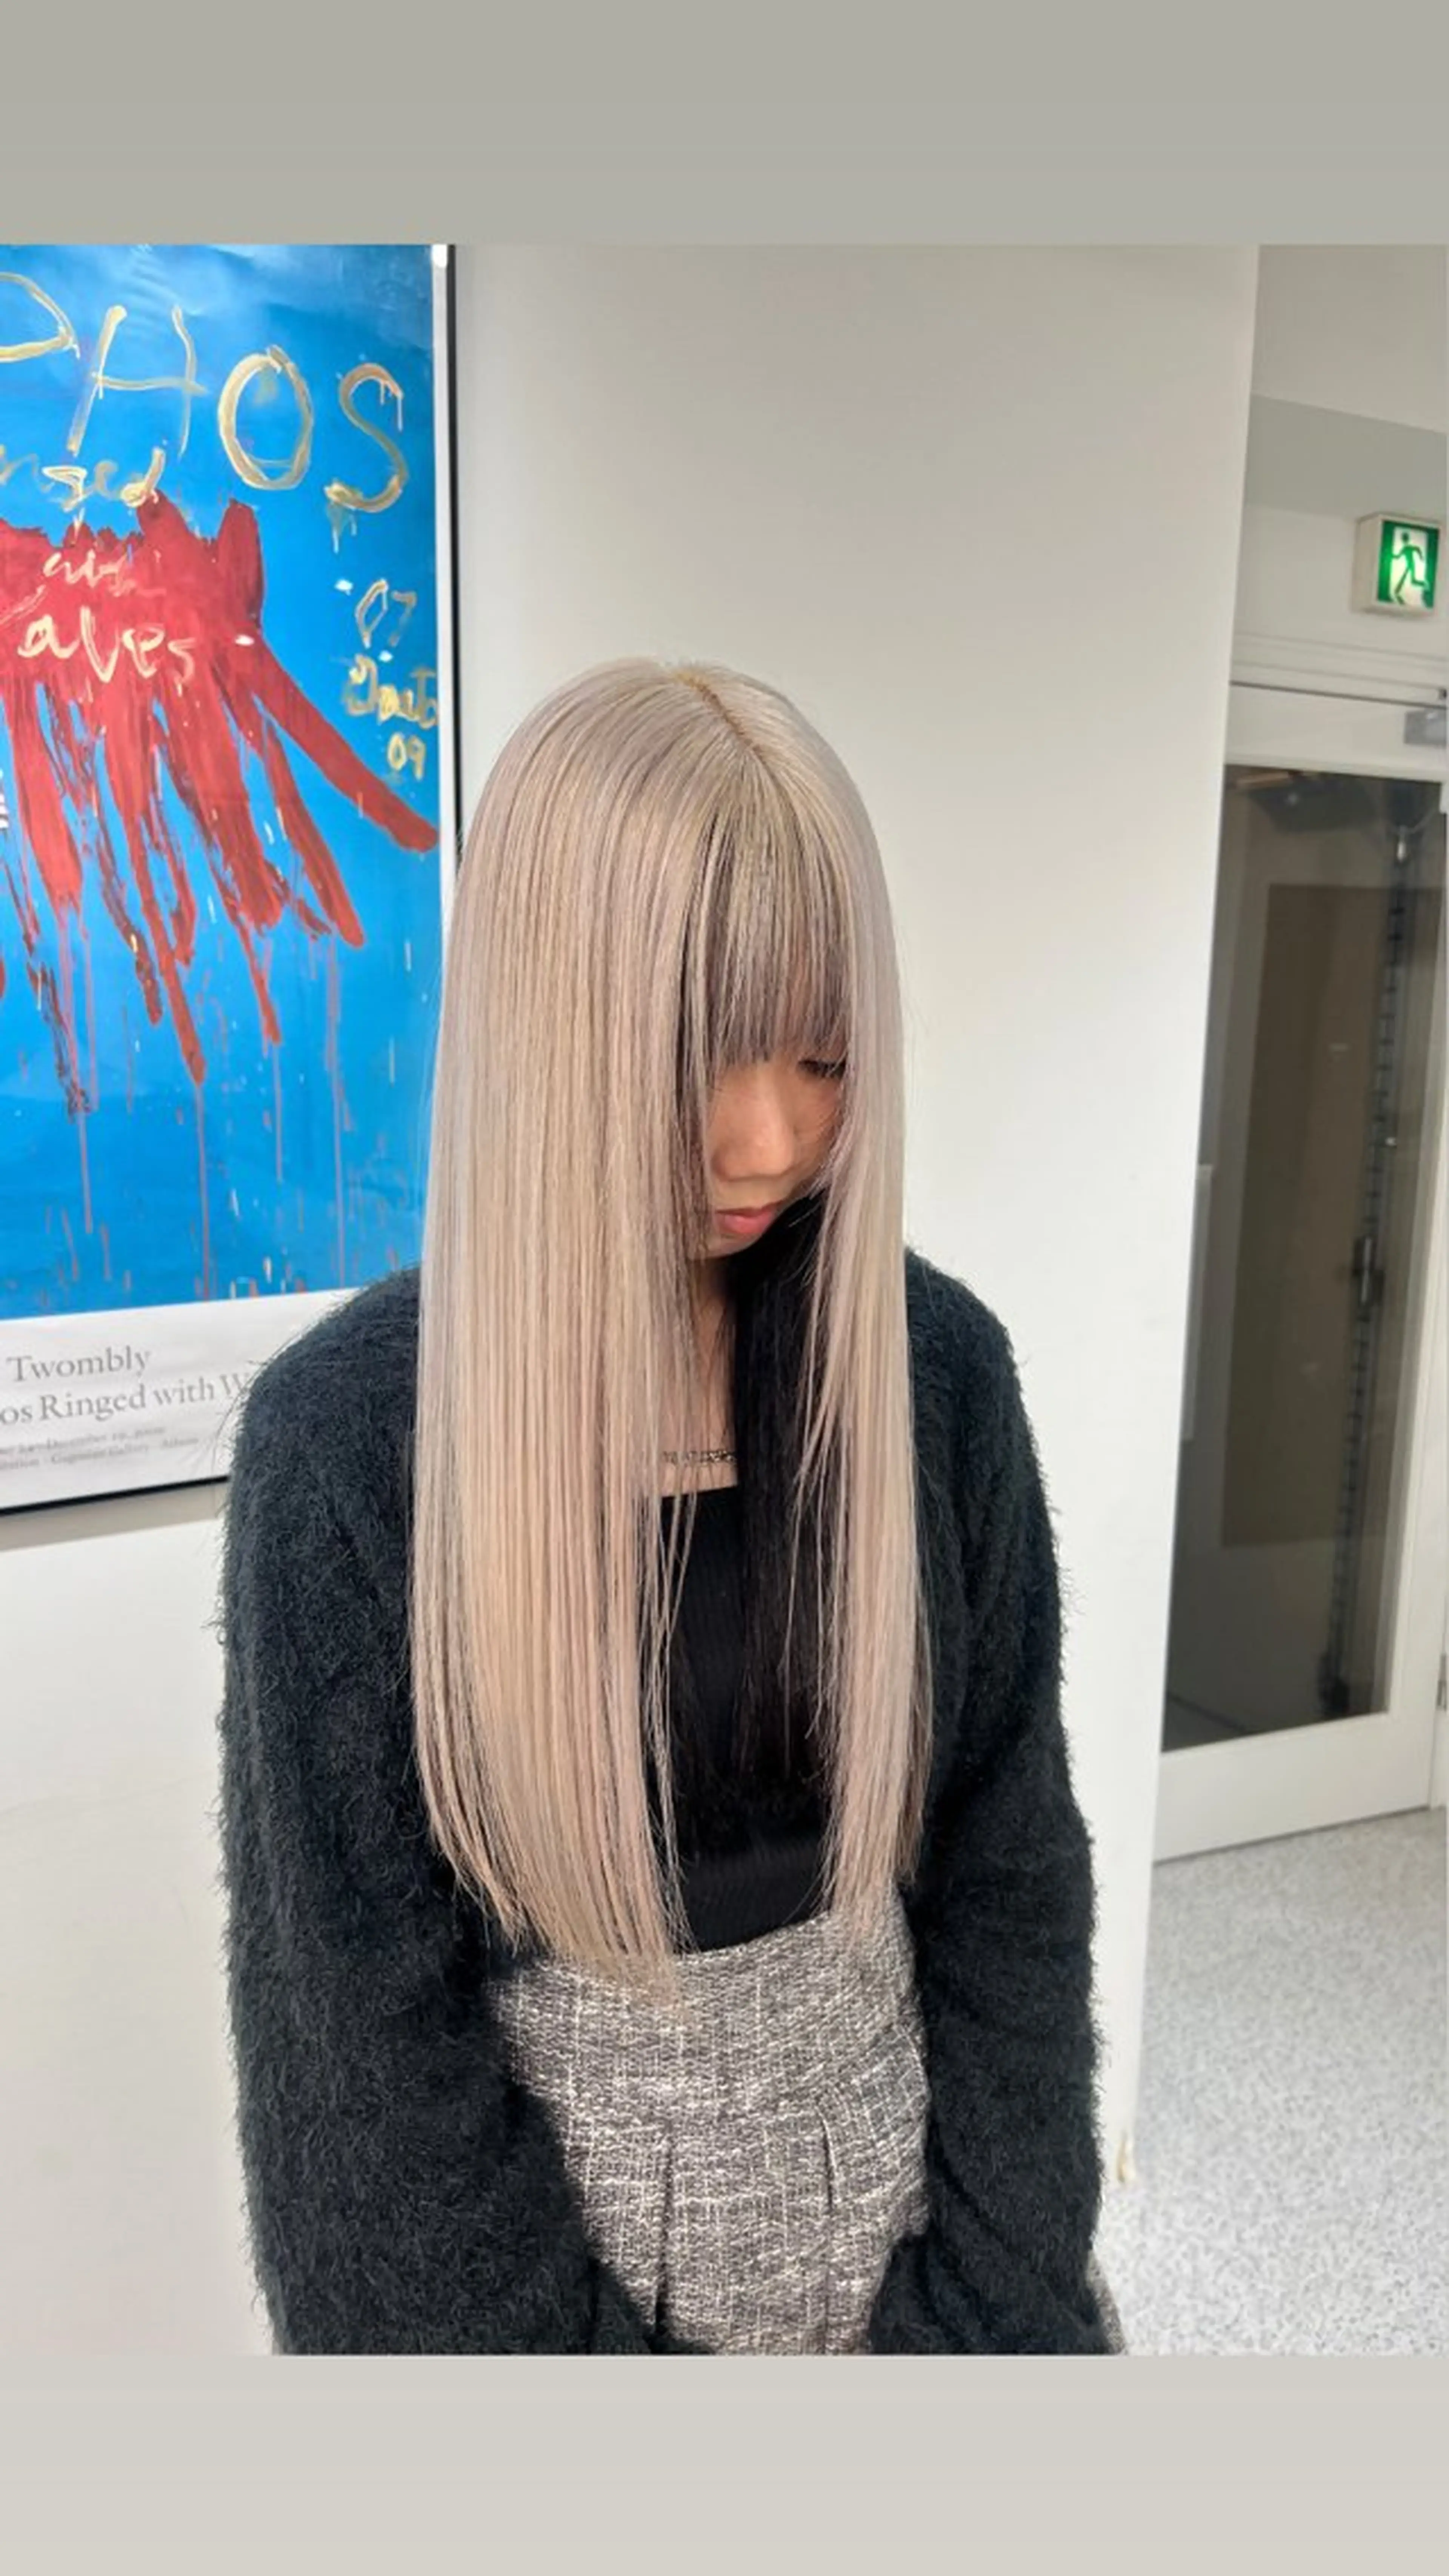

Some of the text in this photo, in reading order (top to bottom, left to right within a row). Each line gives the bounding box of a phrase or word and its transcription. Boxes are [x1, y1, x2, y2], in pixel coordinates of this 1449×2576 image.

[387, 733, 425, 780] 09
[7, 1344, 151, 1383] Twombly
[0, 1405, 33, 1425] os
[39, 1383, 147, 1421] Ringed
[153, 1376, 215, 1406] with
